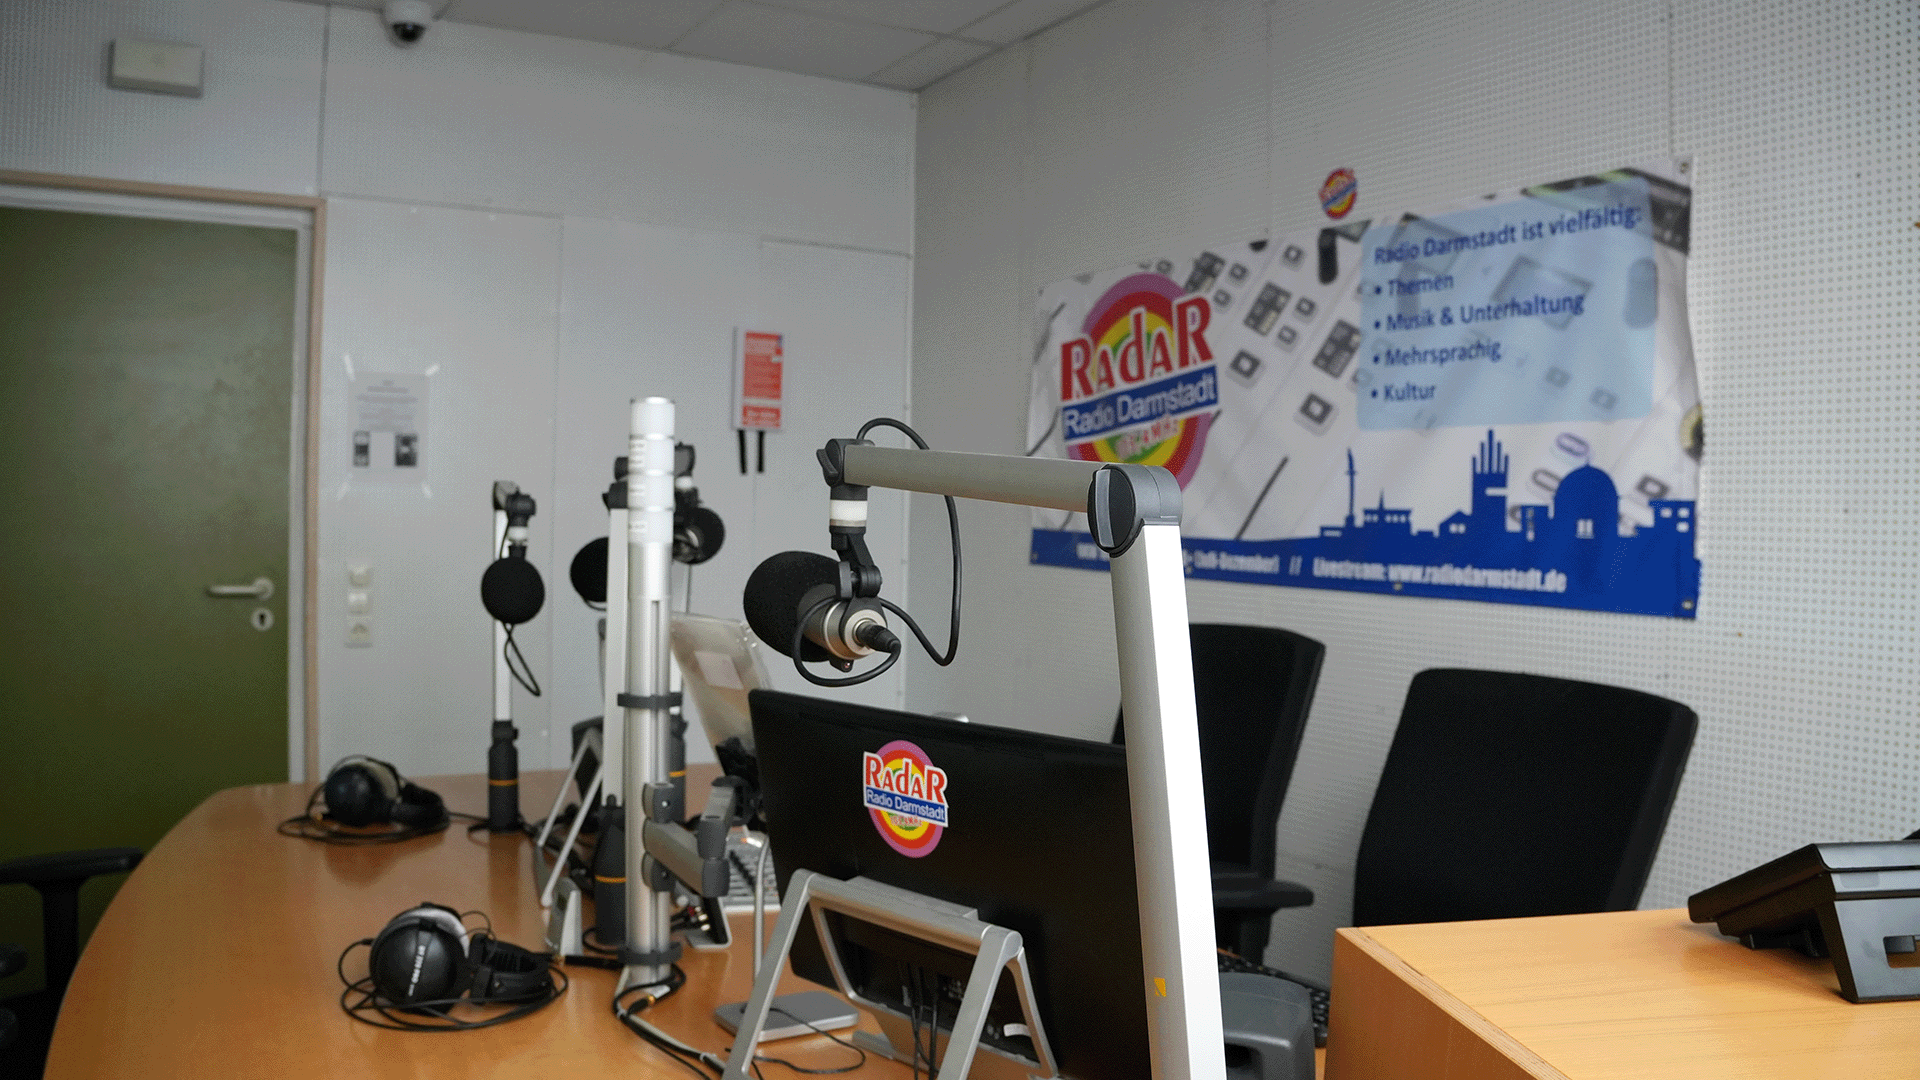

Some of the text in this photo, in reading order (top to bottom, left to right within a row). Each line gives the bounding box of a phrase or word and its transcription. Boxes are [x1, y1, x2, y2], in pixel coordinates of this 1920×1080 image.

[1374, 203, 1641, 265] Radio Darmstadt ist vielfältig:
[1388, 273, 1453, 297] Themen
[1386, 293, 1584, 332] Musik & Unterhaltung
[1385, 340, 1501, 367] Mehrsprachig
[1064, 375, 1215, 438] Radio Darmstadt
[1384, 382, 1436, 402] Kultur
[1388, 562, 1567, 593] www.radiodarmstadt.de
[867, 789, 945, 820] Radio Darmstadt
